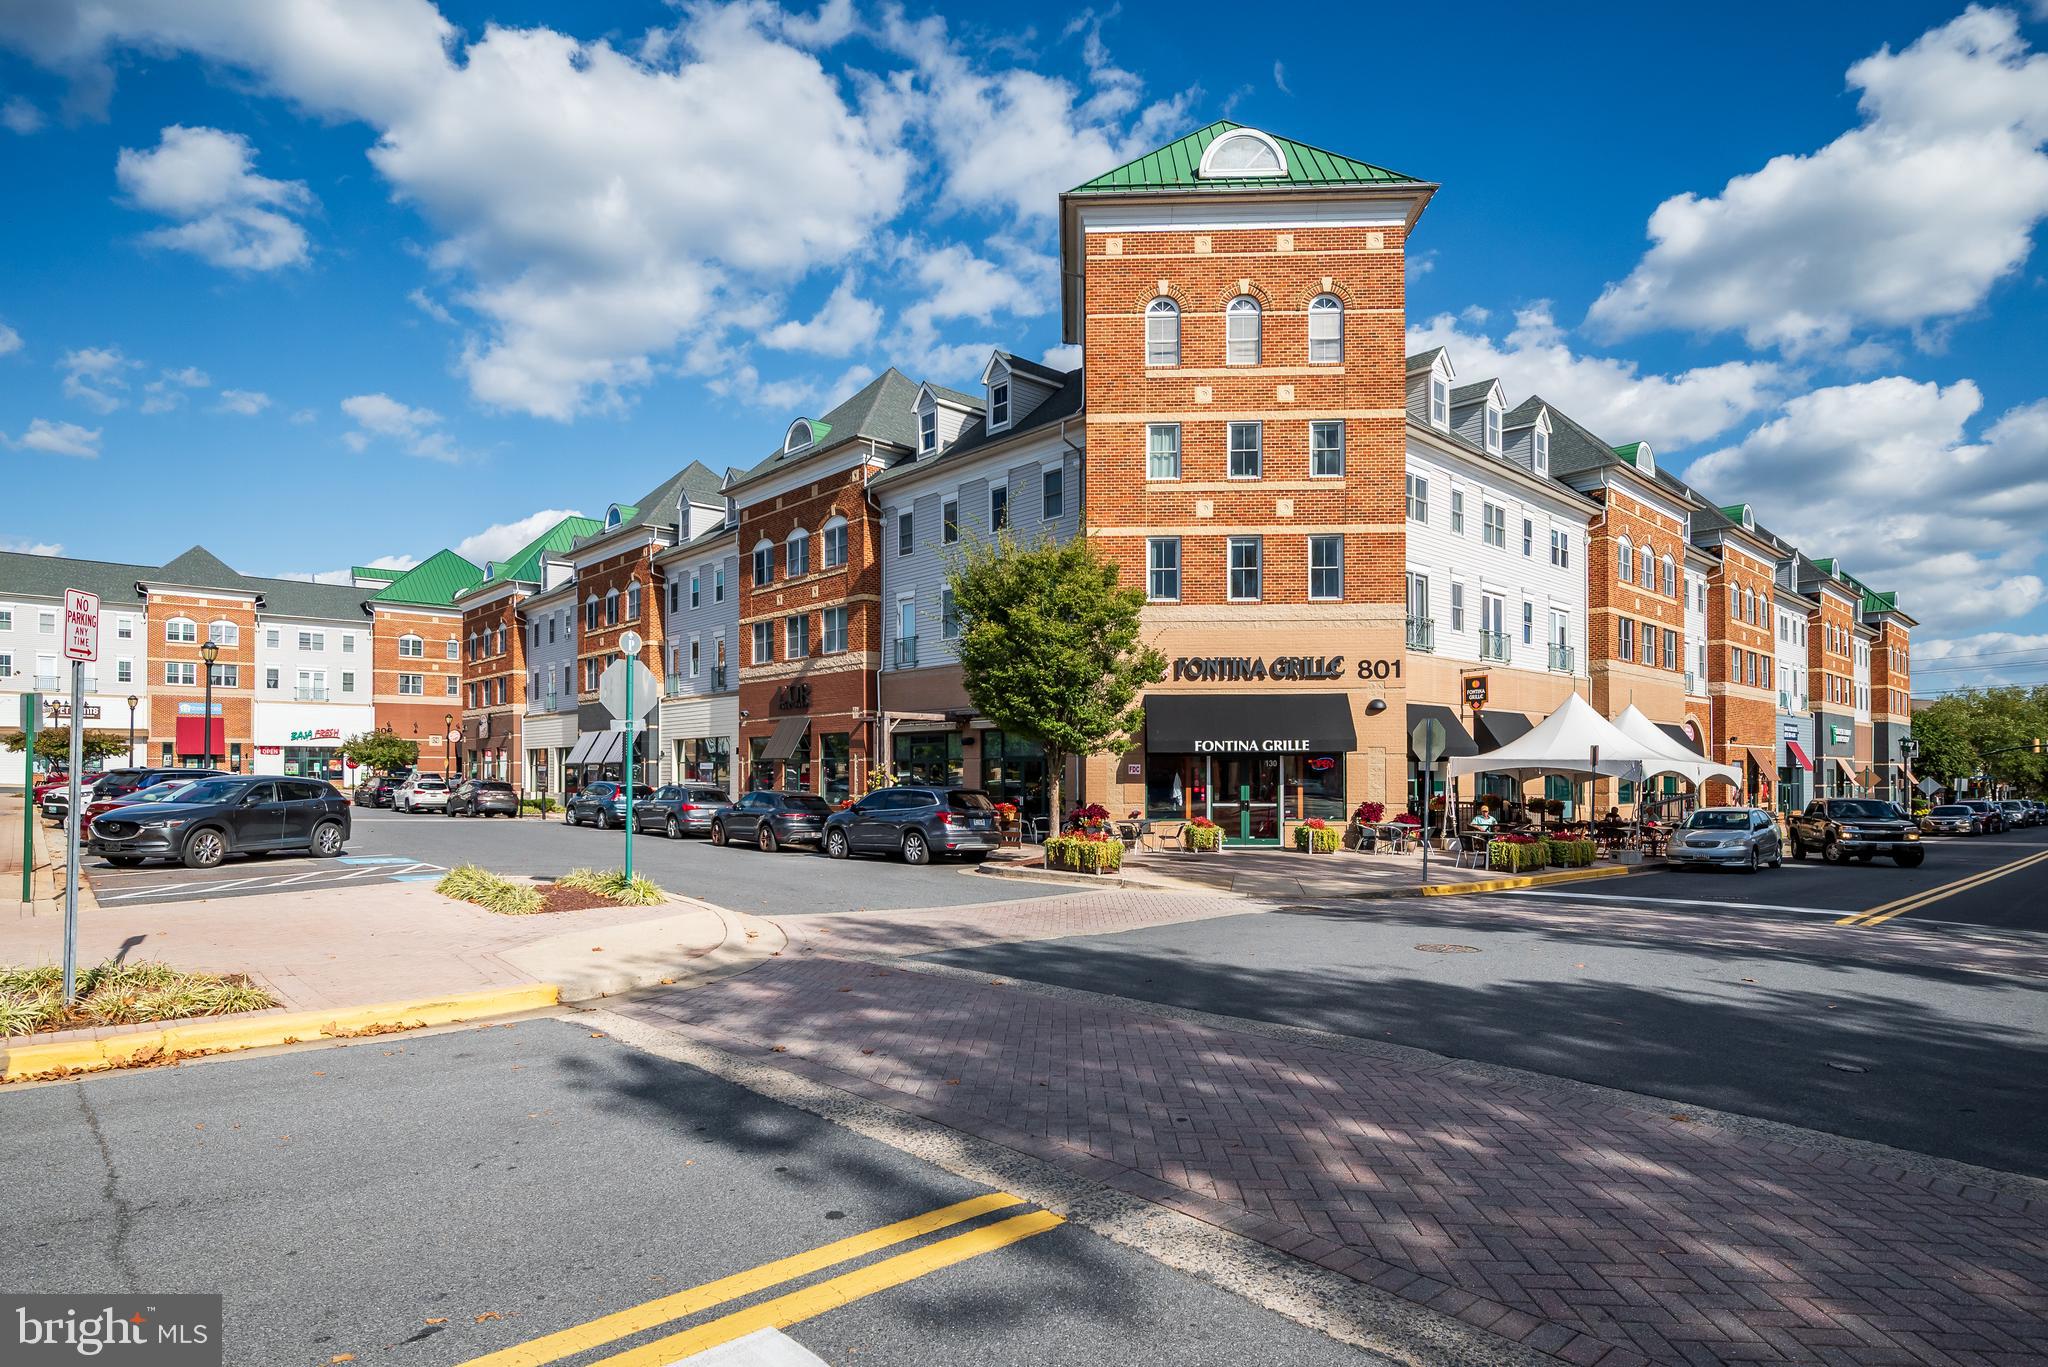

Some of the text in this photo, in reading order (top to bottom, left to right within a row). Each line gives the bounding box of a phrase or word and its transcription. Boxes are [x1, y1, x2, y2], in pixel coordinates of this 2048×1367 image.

[76, 598, 89, 612] NO
[67, 610, 97, 628] PARKING
[75, 626, 89, 637] ANY
[74, 636, 90, 647] TIME
[628, 639, 635, 651] P
[1174, 655, 1346, 680] FONTINA GRILLE
[1357, 659, 1401, 680] 801
[290, 730, 313, 741] BAJA
[1194, 740, 1310, 752] FONTINA GRILLE
[1264, 759, 1278, 767] 130
